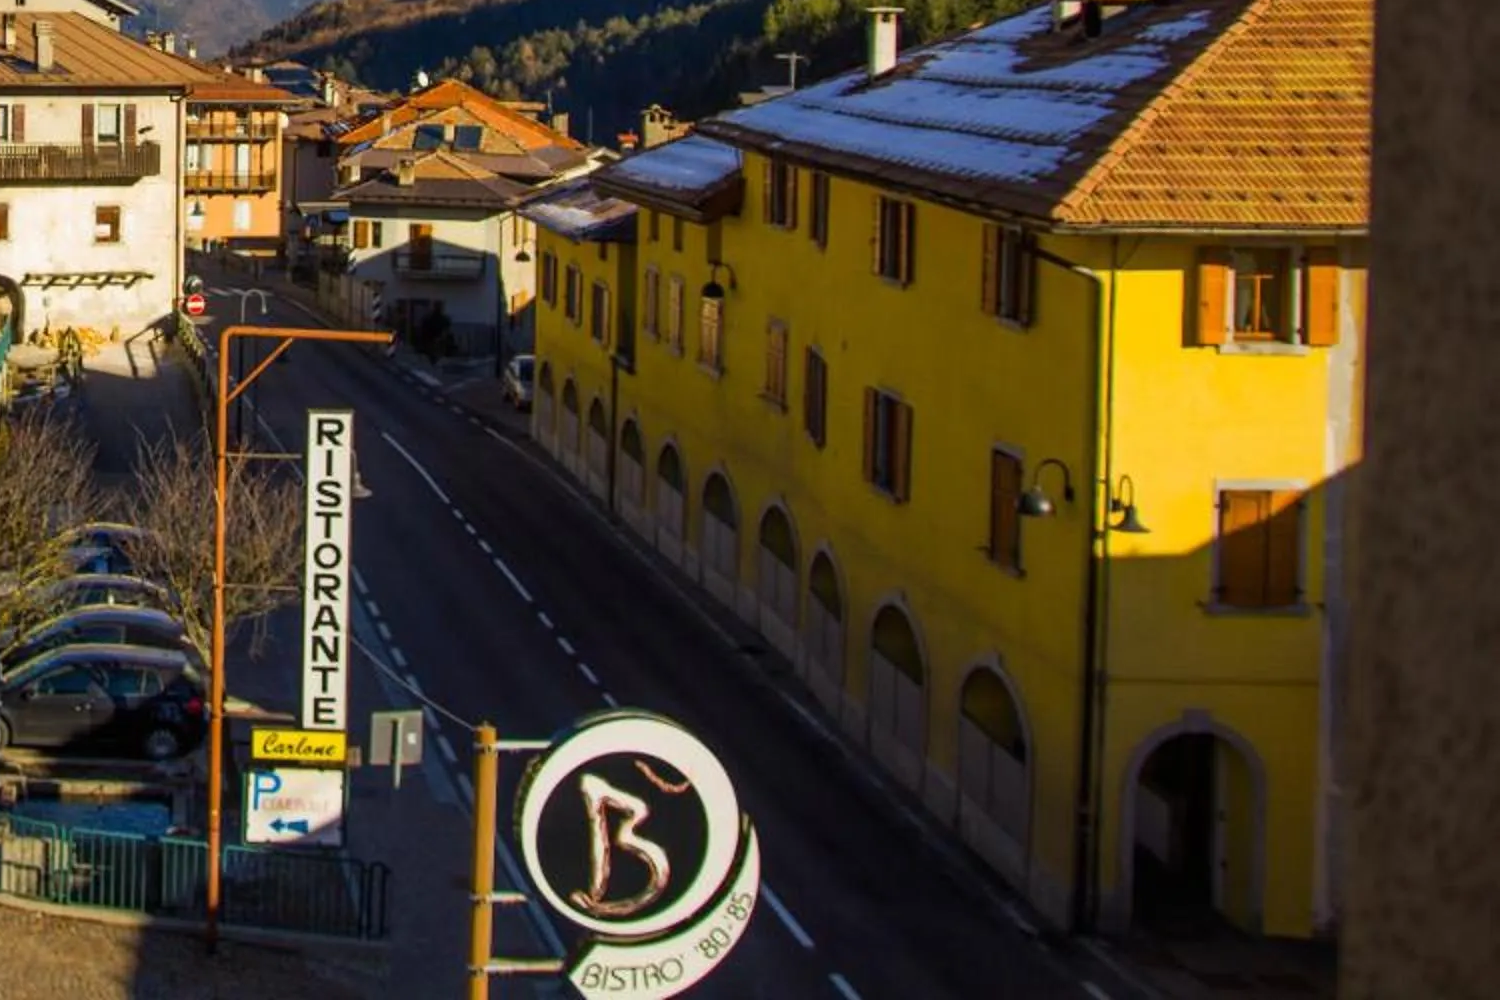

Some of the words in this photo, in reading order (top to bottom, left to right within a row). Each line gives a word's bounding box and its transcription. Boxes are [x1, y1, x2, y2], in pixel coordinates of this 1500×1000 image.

[311, 417, 345, 726] RISTORANTE
[262, 732, 337, 757] Carlone
[253, 770, 282, 811] P
